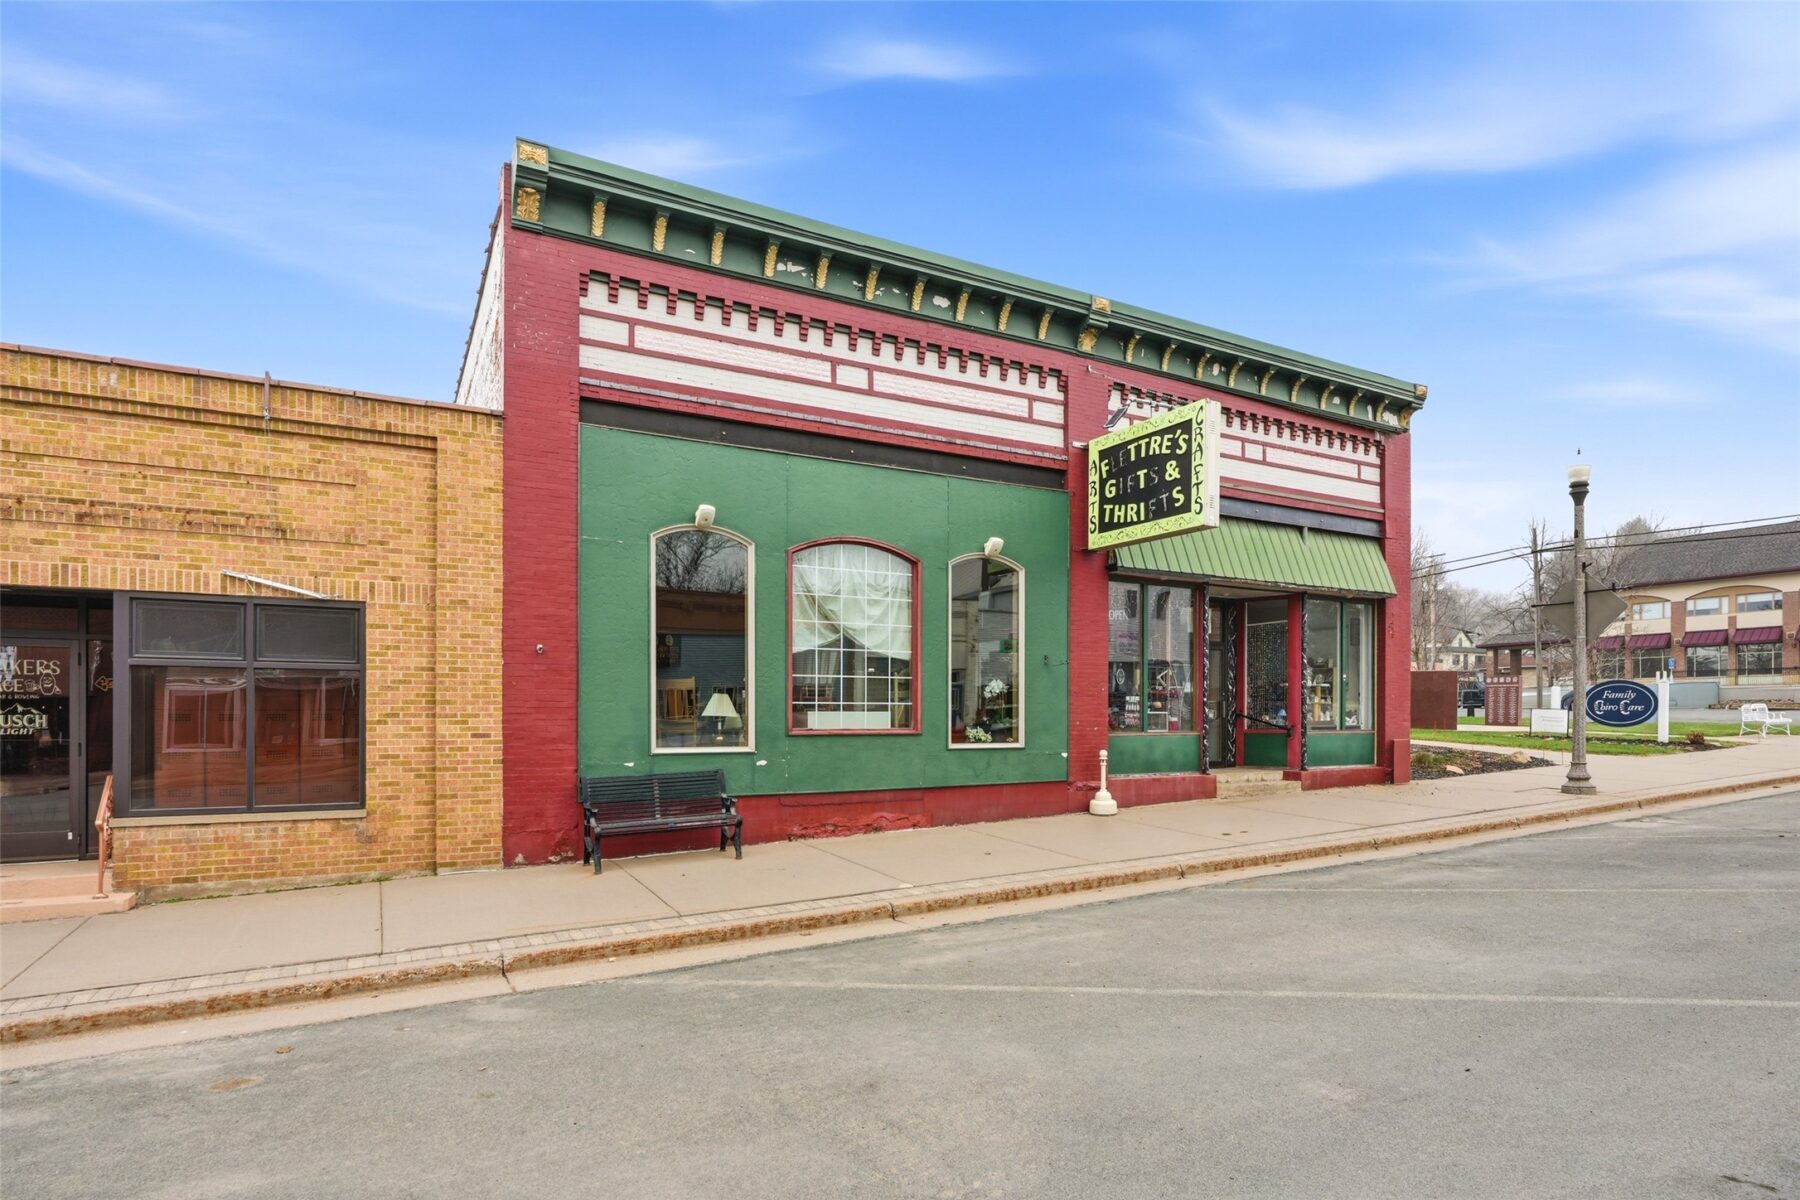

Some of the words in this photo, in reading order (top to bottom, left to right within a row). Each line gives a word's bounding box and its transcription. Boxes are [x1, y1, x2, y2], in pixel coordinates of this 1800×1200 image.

[1192, 405, 1204, 515] CRAFTS
[1089, 459, 1098, 534] ARTS
[1105, 466, 1159, 498] GIFTS
[1165, 460, 1181, 482] &
[1103, 486, 1185, 523] THRIFTS
[1594, 699, 1618, 715] Chiro
[1619, 699, 1645, 715] Care
[1602, 689, 1637, 700] Family
